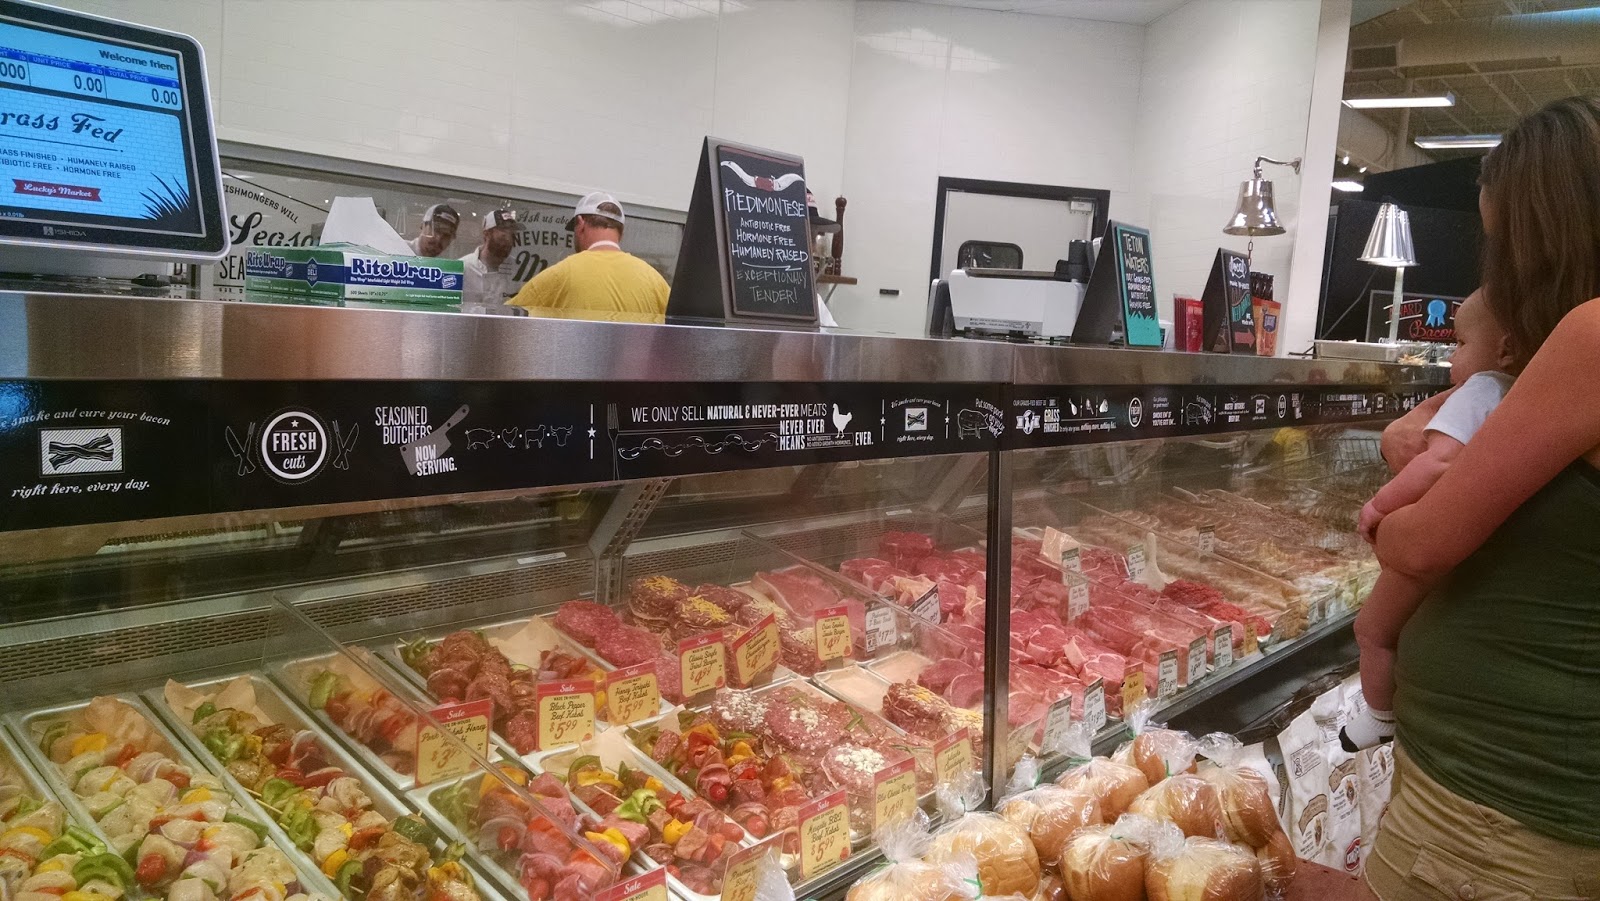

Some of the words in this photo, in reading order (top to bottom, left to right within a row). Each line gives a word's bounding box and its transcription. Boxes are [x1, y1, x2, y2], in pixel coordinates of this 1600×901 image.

[33, 56, 49, 65] UNIT
[50, 60, 71, 69] PRICE
[98, 49, 148, 67] Welcome
[73, 74, 103, 93] 0.00
[108, 69, 129, 79] TOTAL
[129, 74, 149, 83] PRICE
[151, 88, 178, 106] 0.00
[0, 112, 60, 131] rass
[71, 112, 124, 143] Fed
[0, 149, 19, 157] ASS
[20, 150, 57, 161] FINISHED
[67, 157, 108, 168] HUMANELY
[109, 161, 136, 172] RAISED
[33, 162, 53, 171] FREE
[63, 166, 101, 177] HORMONE
[102, 170, 121, 179] FREE
[23, 183, 57, 196] Lucky's
[58, 186, 92, 198] Market
[280, 206, 299, 224] WILL
[517, 211, 541, 223] Ask
[542, 216, 553, 224] us
[54, 227, 87, 237] ISHIDA
[230, 211, 320, 247] Seaso
[740, 217, 774, 231] ANTIBIOTIC
[774, 221, 791, 232] FREE
[736, 229, 772, 244] HORMONE
[773, 234, 796, 247] FREE
[1122, 233, 1144, 255] TETON
[731, 243, 775, 261] HUMANELY
[775, 247, 808, 263] RAISED
[351, 257, 443, 282] RiteWrap
[1124, 252, 1149, 274] WATERS
[749, 285, 798, 304] TENDER!
[1409, 320, 1457, 339] Bacon
[11, 409, 51, 427] smoke
[54, 408, 78, 419] and
[79, 409, 106, 418] cure
[109, 410, 137, 420] your
[140, 412, 171, 426] bacon
[375, 406, 428, 427] SEASONED
[631, 407, 649, 423] WE
[651, 406, 679, 422] ONLY
[681, 405, 705, 421] SELL
[707, 404, 743, 420] NATURAL
[744, 404, 751, 419] &
[751, 403, 800, 419] NEVER-EVER
[800, 402, 828, 418] MEATS
[1044, 408, 1061, 423] GRASS
[779, 419, 804, 437] NEVER
[806, 419, 825, 435] EVER
[272, 431, 317, 452] FRESH
[779, 435, 806, 451] MEANS
[854, 431, 874, 447] EVER.
[282, 452, 306, 470] cuts
[415, 444, 437, 461] NOW
[416, 457, 458, 477] SERVING.
[11, 484, 48, 498] right
[50, 482, 83, 495] here,
[87, 480, 122, 492] every
[125, 478, 150, 491] day.
[625, 669, 639, 677] Sale
[560, 684, 575, 692] Sale
[447, 710, 465, 720] Sale
[549, 701, 565, 711] Black
[567, 701, 586, 711] Pepper
[551, 711, 565, 721] Beef
[465, 724, 486, 733] Honey
[624, 881, 642, 895] Sale
